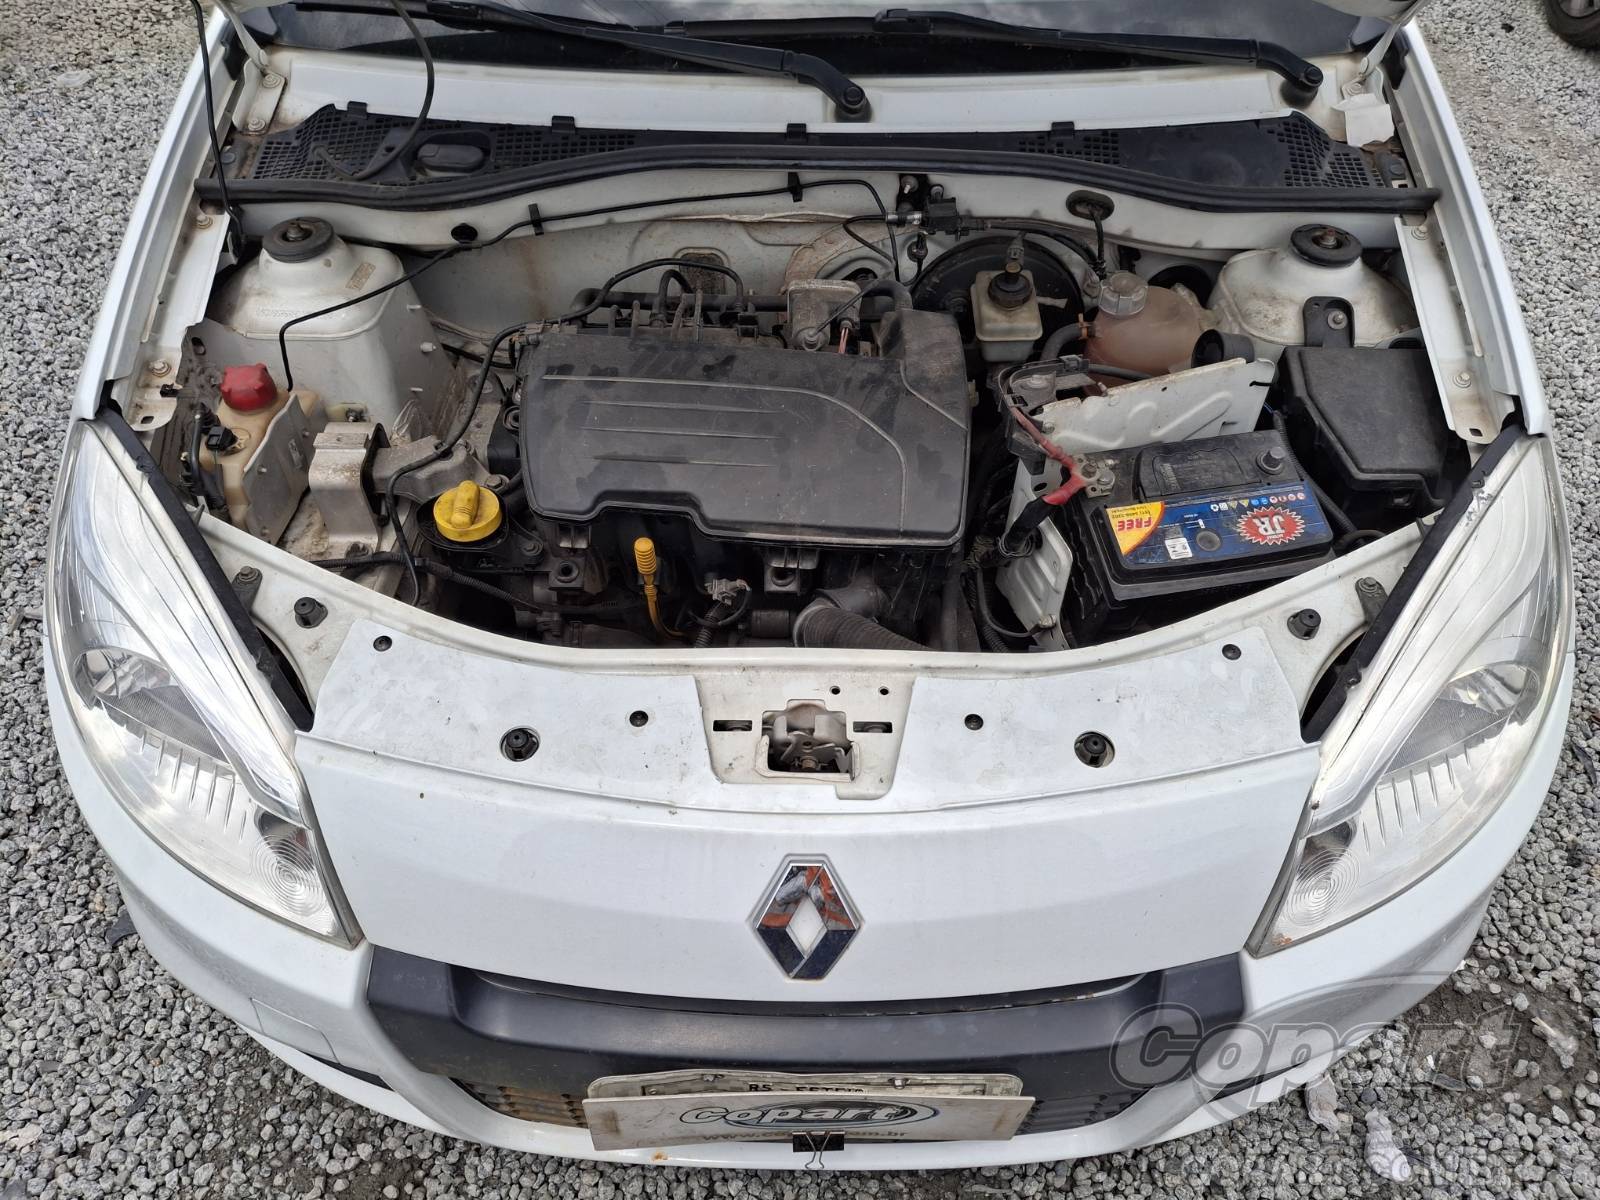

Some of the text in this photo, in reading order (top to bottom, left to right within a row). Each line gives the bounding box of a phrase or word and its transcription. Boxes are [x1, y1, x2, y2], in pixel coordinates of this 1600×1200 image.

[1117, 517, 1152, 531] FREE
[1252, 515, 1285, 536] JR
[679, 1106, 901, 1125] Copart
[702, 1128, 908, 1141] www.coom.br
